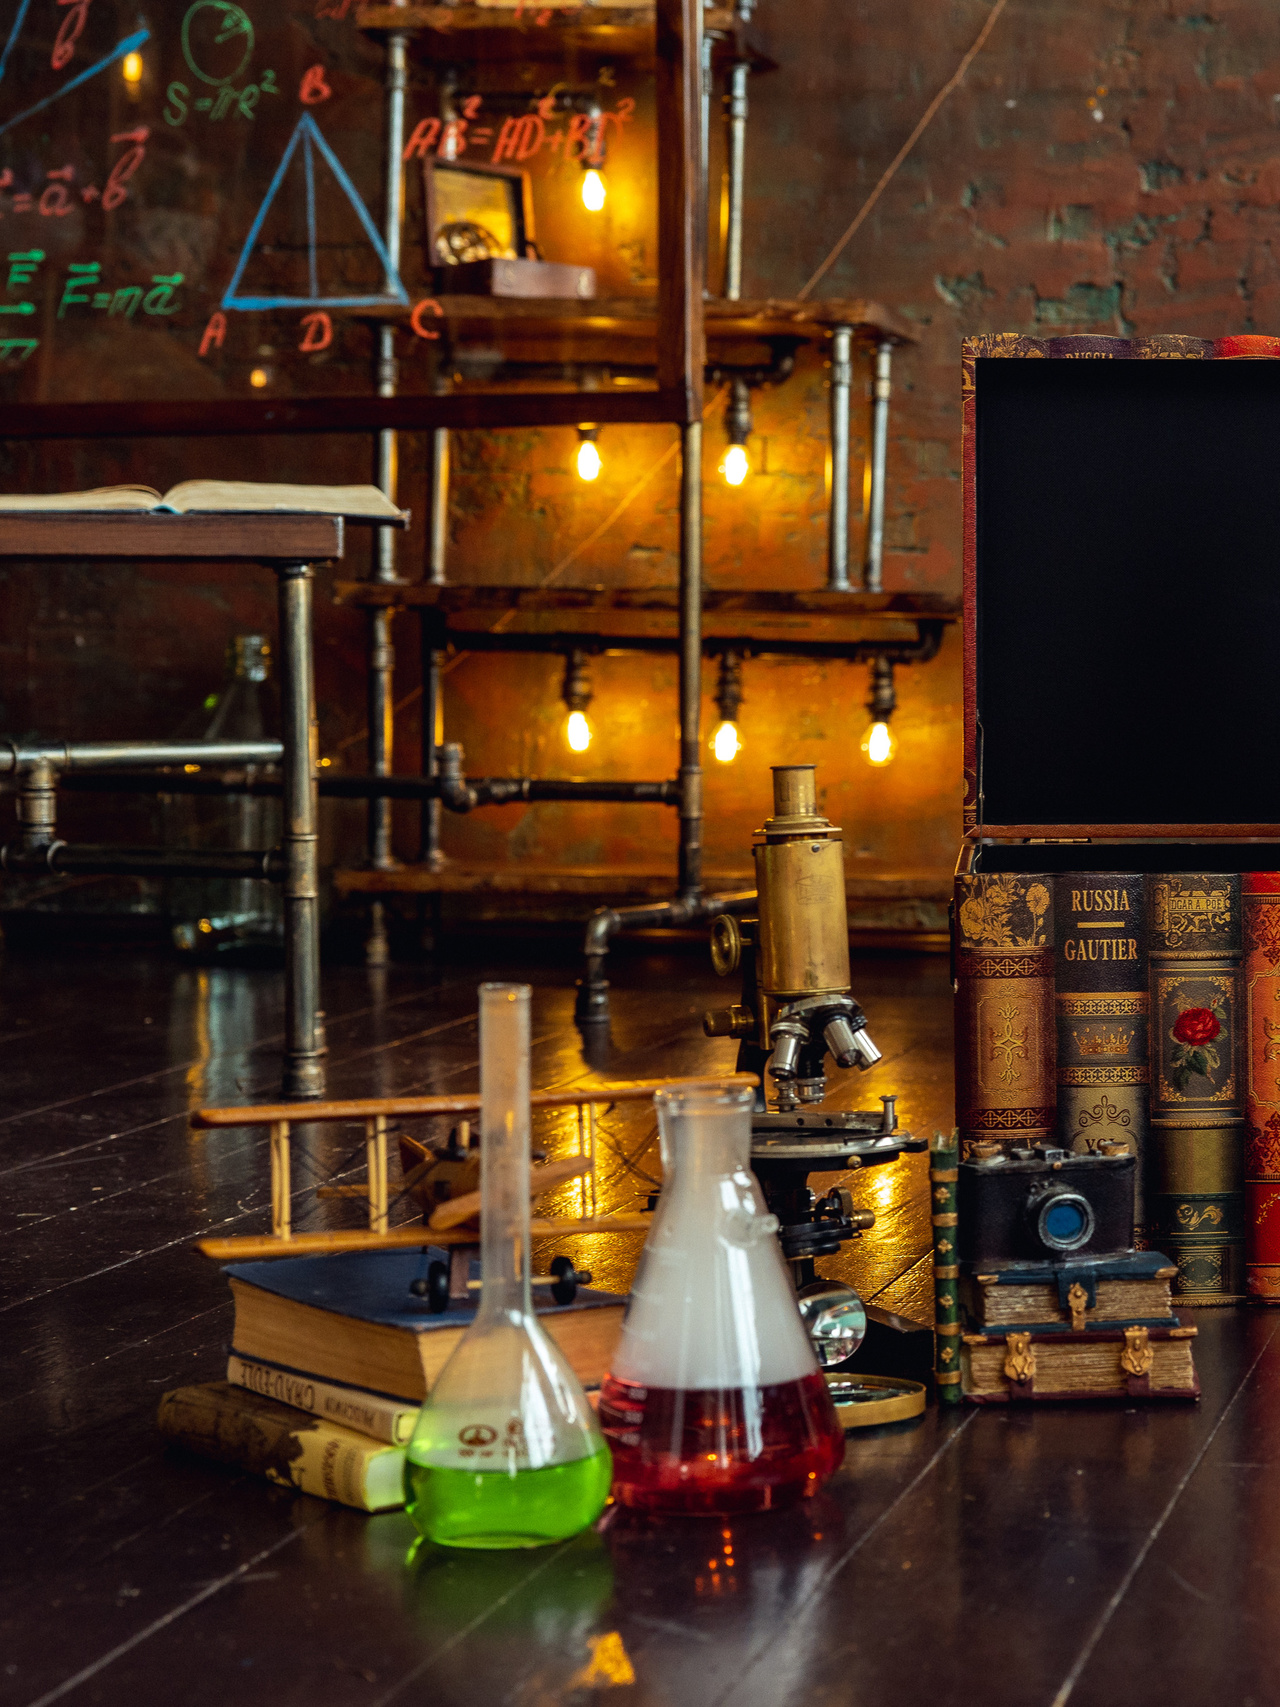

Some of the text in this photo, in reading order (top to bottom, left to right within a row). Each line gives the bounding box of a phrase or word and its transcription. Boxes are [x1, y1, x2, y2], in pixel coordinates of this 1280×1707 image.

[199, 312, 227, 357] A
[299, 312, 333, 352] D
[411, 300, 444, 340] C
[1071, 889, 1131, 912] RUSSIA
[1064, 938, 1138, 961] GAUTIER
